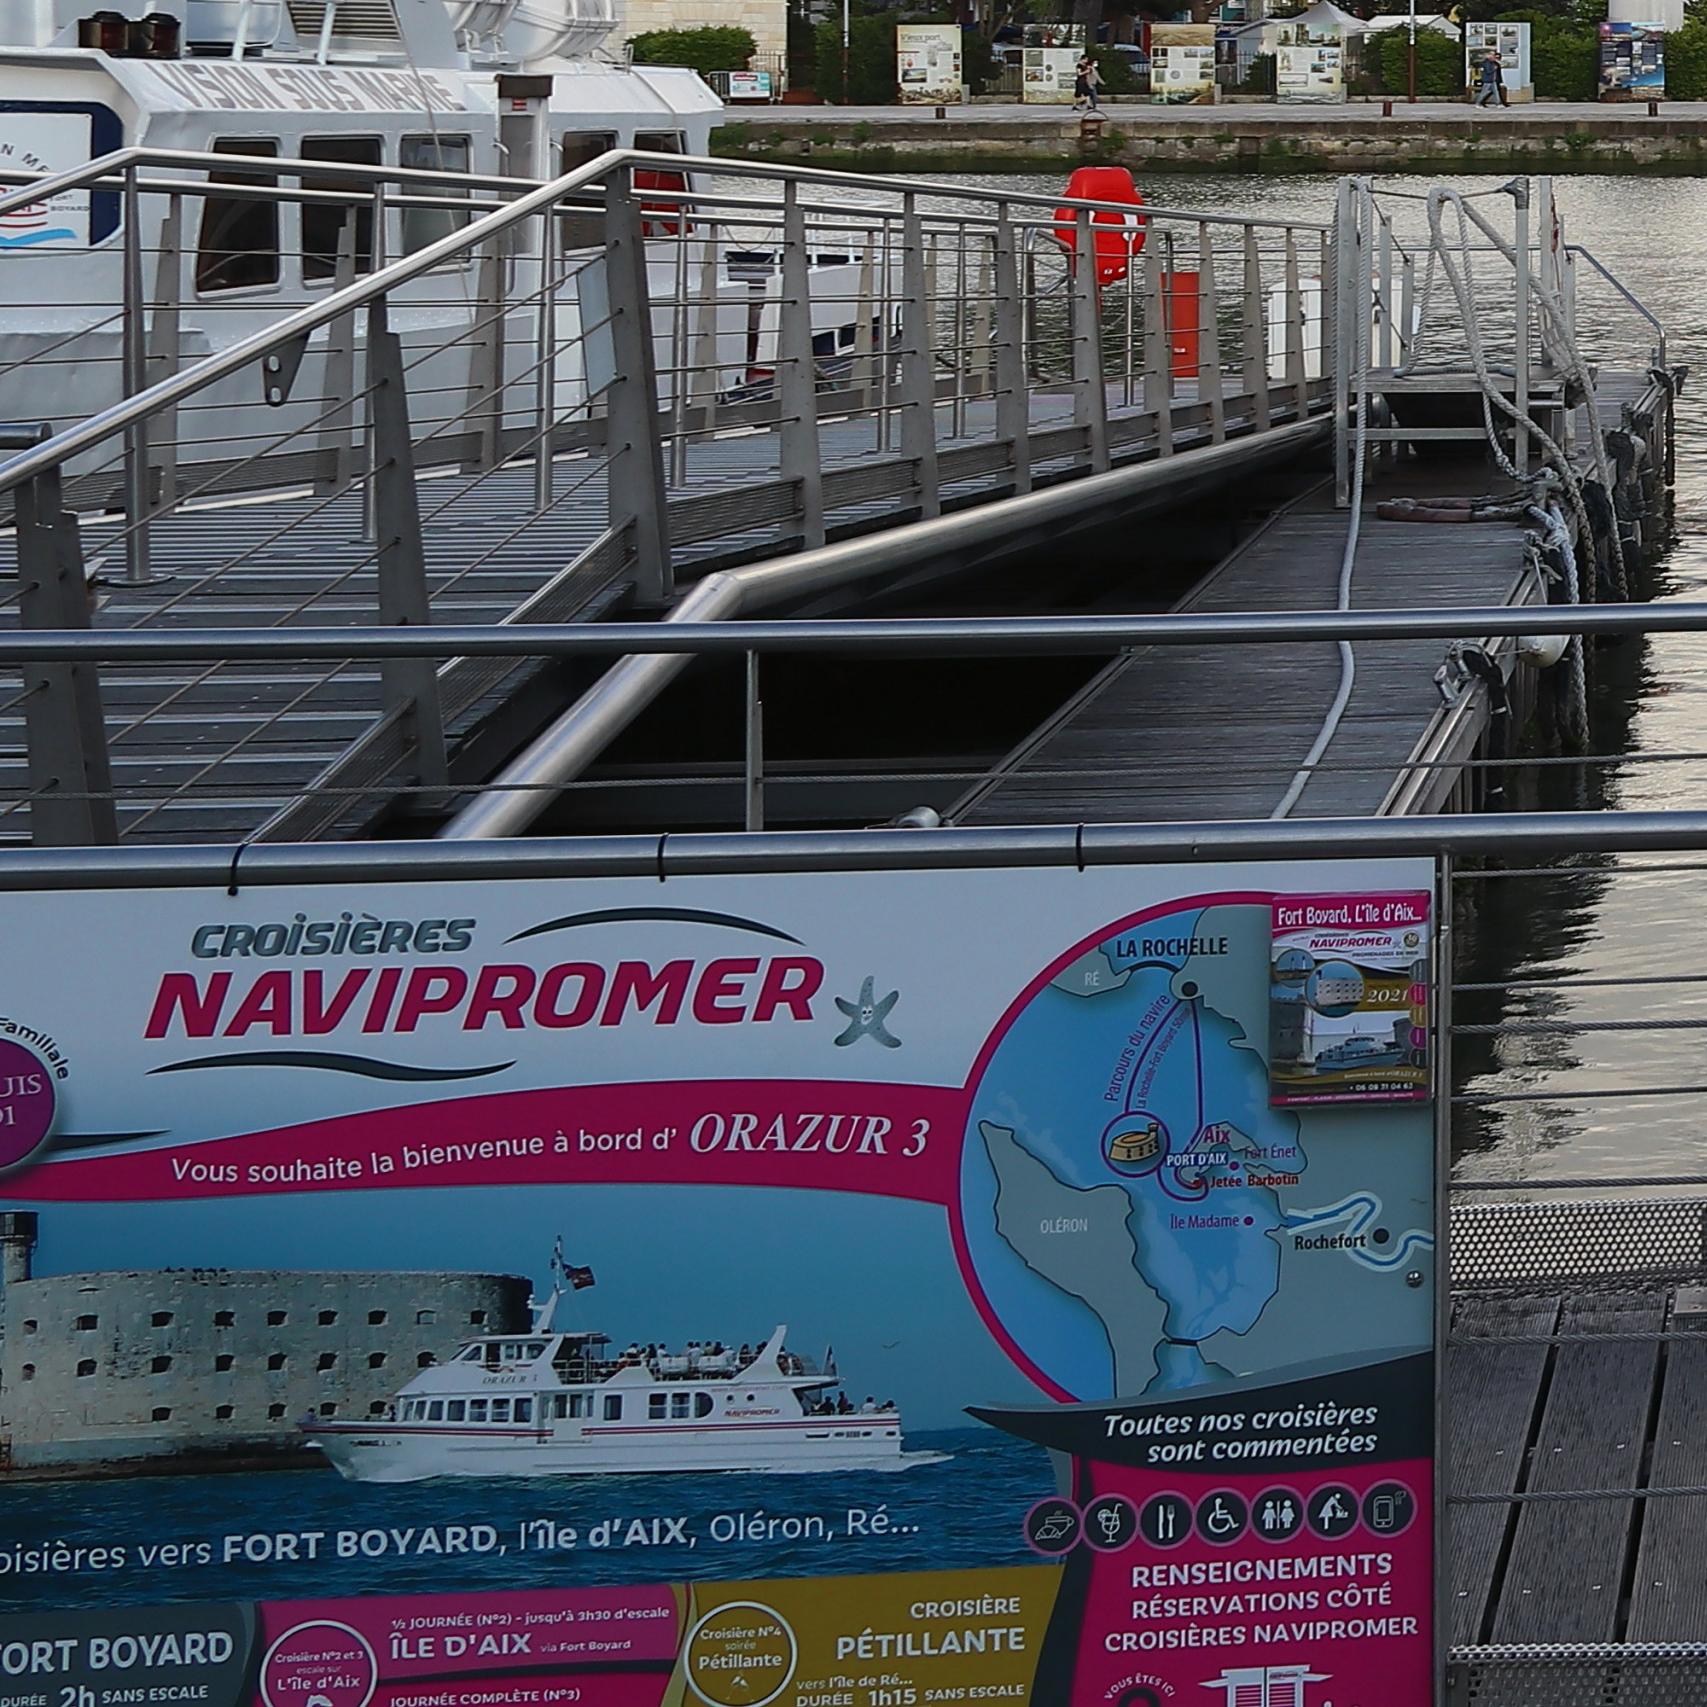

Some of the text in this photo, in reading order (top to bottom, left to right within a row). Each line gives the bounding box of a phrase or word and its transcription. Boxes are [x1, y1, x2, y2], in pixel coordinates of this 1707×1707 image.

[145, 61, 466, 112] VISION SOUS MARINE
[1278, 907, 1302, 926] Fort
[1306, 904, 1352, 926] Boyard,
[192, 912, 476, 959] CROISIÈRES
[1309, 935, 1392, 949] NAVIPROMER
[1116, 937, 1228, 958] LA ROCHELLE
[1084, 970, 1100, 986] RÉ
[145, 956, 825, 1039] NAVIPROMER
[1366, 988, 1408, 1003] 2021
[1103, 994, 1171, 1102] Parcours du navire
[1203, 1126, 1231, 1144] Aix
[172, 1112, 931, 1184] Vous souhaite la bienvenue à bord d' ORAZUR 3
[1166, 1152, 1227, 1166] PORT D'AIX
[1244, 1143, 1297, 1159] Fort Énet
[1210, 1172, 1299, 1187] Jetée Barbotin
[1040, 1215, 1089, 1234] OLÉRON
[1170, 1213, 1240, 1229] Île Madame
[1294, 1232, 1367, 1250] Rochefort
[1105, 1400, 1379, 1438] Toutes nos croisières
[1148, 1428, 1379, 1464] sont commentées
[139, 1540, 212, 1567] vers
[223, 1529, 325, 1564] FORT
[336, 1523, 508, 1559] BOYARD,
[518, 1518, 578, 1552] l'île
[588, 1514, 698, 1551] d'AIX,
[710, 1507, 835, 1544] Oléron,
[847, 1505, 919, 1536] Ré...
[1131, 1554, 1393, 1588] RENSEIGNEMENTS
[910, 1595, 1021, 1620] CROISIÈRE
[1131, 1580, 1393, 1620] RÉSERVATIONS CÔTÉ
[408, 1613, 474, 1630] JOURNÉE
[523, 1610, 575, 1626] jusqu'à
[578, 1610, 612, 1622] 3h30
[614, 1606, 670, 1621] d'escale
[700, 1626, 757, 1641] Croisière
[836, 1626, 1026, 1661] PÉTILLANTE
[1104, 1614, 1419, 1653] CROISIÈRES NAVIPROMER
[0, 1631, 234, 1675] ORT BOYARD
[389, 1631, 632, 1660] ÎLE D'AIX via Fort Boyard
[725, 1639, 757, 1651] soirée
[275, 1651, 320, 1664] Croisière
[343, 1651, 355, 1661] et
[698, 1651, 783, 1671] Pétillante
[296, 1665, 342, 1675] escale sur
[277, 1674, 361, 1691] L'île d'Aix
[796, 1672, 914, 1691] vers l'île de Ré...
[1104, 1672, 1177, 1700] VOUS ÊTES ICI
[1, 1684, 209, 1707] DURÉE 2h SANS ESCALE
[390, 1693, 457, 1707] JOURNÉE
[460, 1687, 540, 1704] COMPLÈTE
[796, 1684, 1025, 1707] DURÉE 1h15 SANS ESCALE
